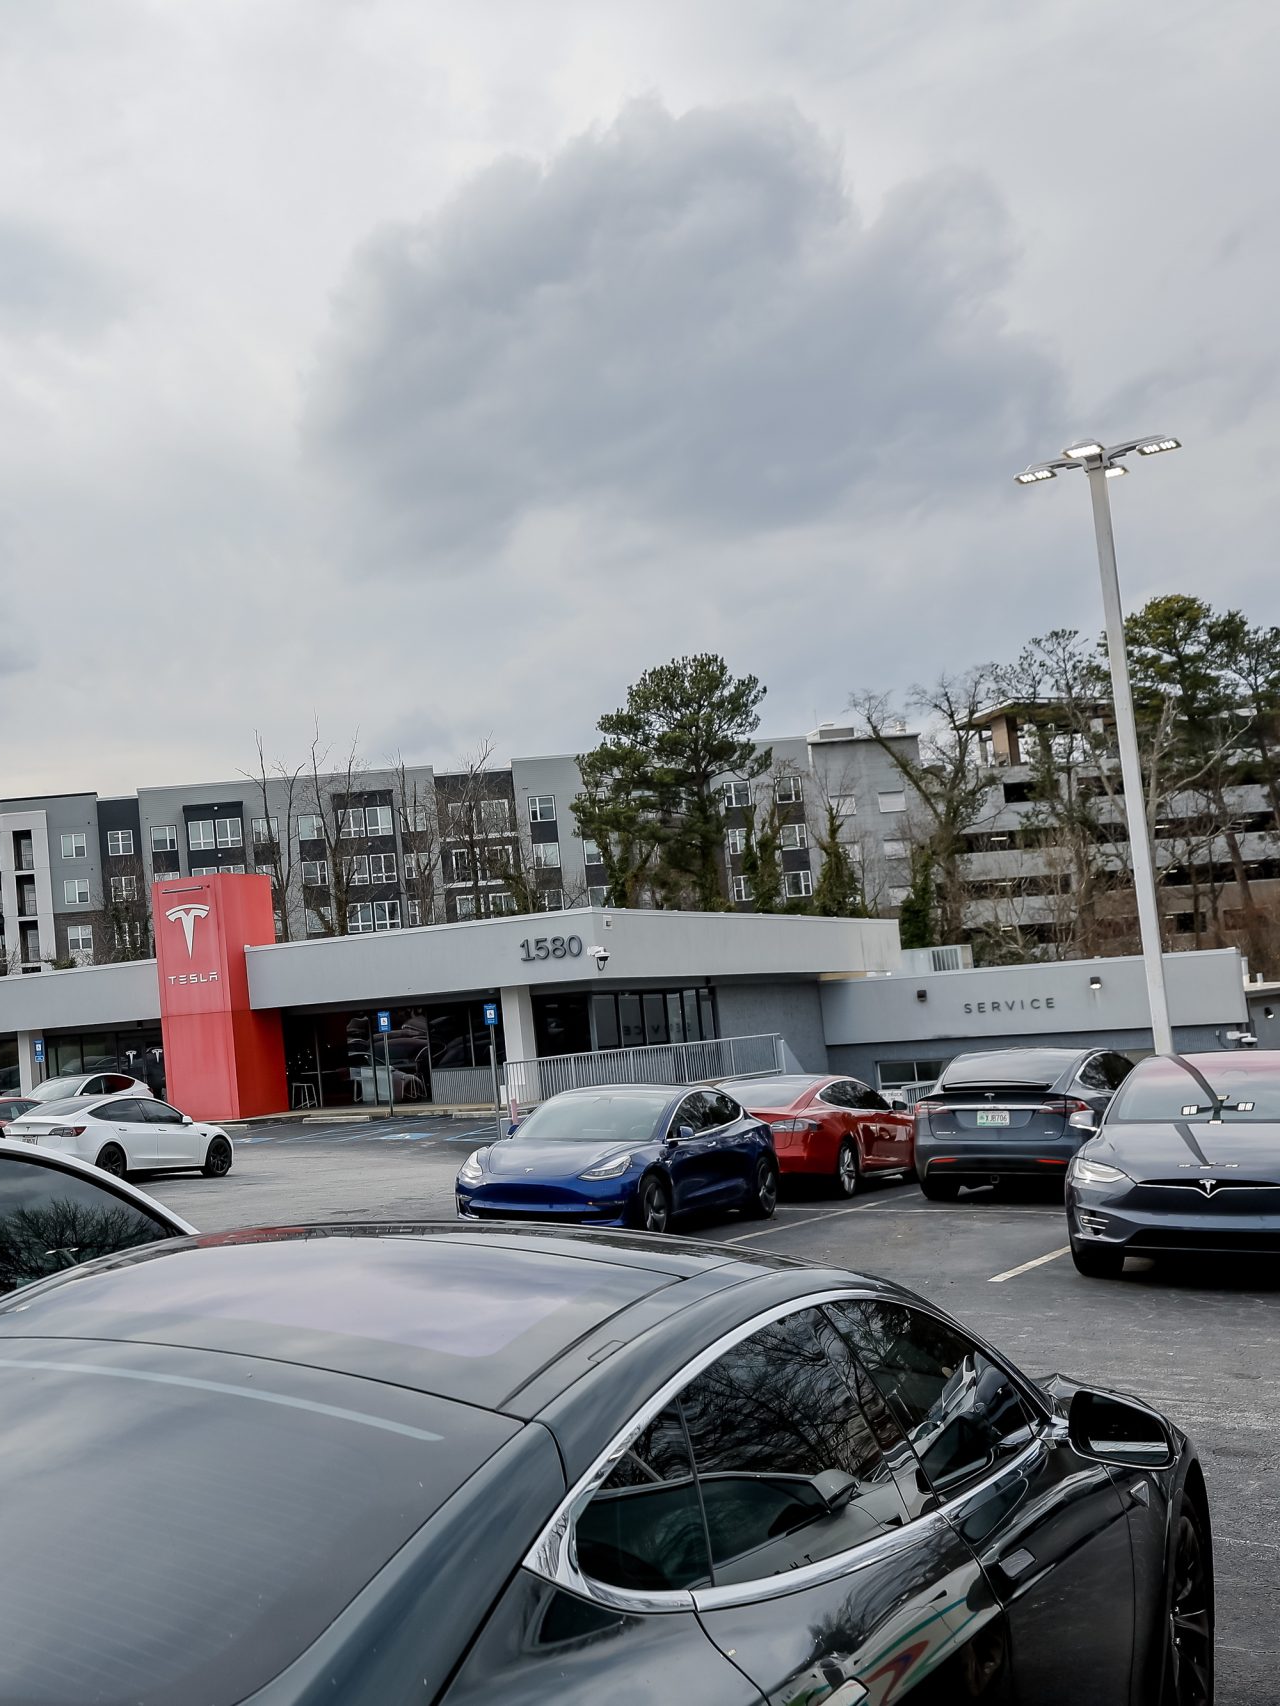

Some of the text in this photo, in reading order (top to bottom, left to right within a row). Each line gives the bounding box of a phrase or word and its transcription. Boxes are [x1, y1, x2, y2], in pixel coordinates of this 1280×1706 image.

[519, 934, 583, 961] 1580
[167, 970, 218, 985] TESLA
[963, 997, 1056, 1014] SERVICE
